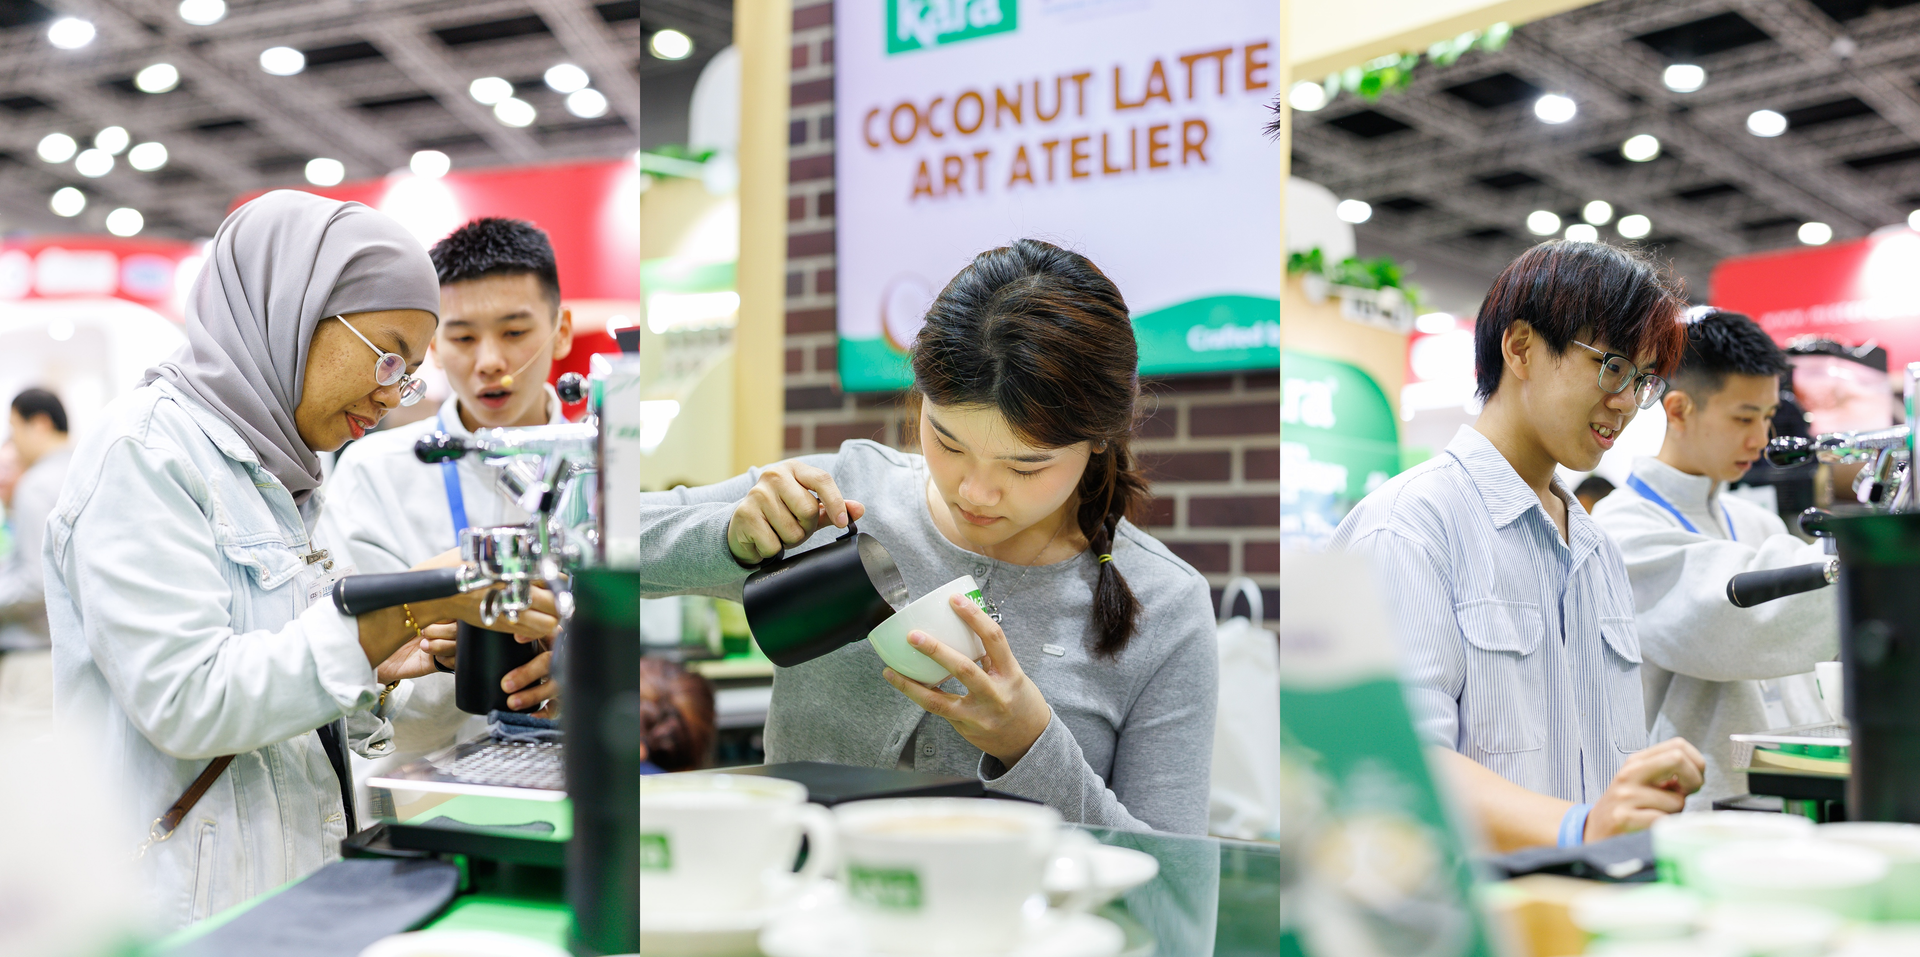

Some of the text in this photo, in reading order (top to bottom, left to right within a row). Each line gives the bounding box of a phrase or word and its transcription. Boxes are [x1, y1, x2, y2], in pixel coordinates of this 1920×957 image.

[862, 40, 1270, 149] COCONUT LATTE
[910, 118, 1209, 200] ART ATELIER
